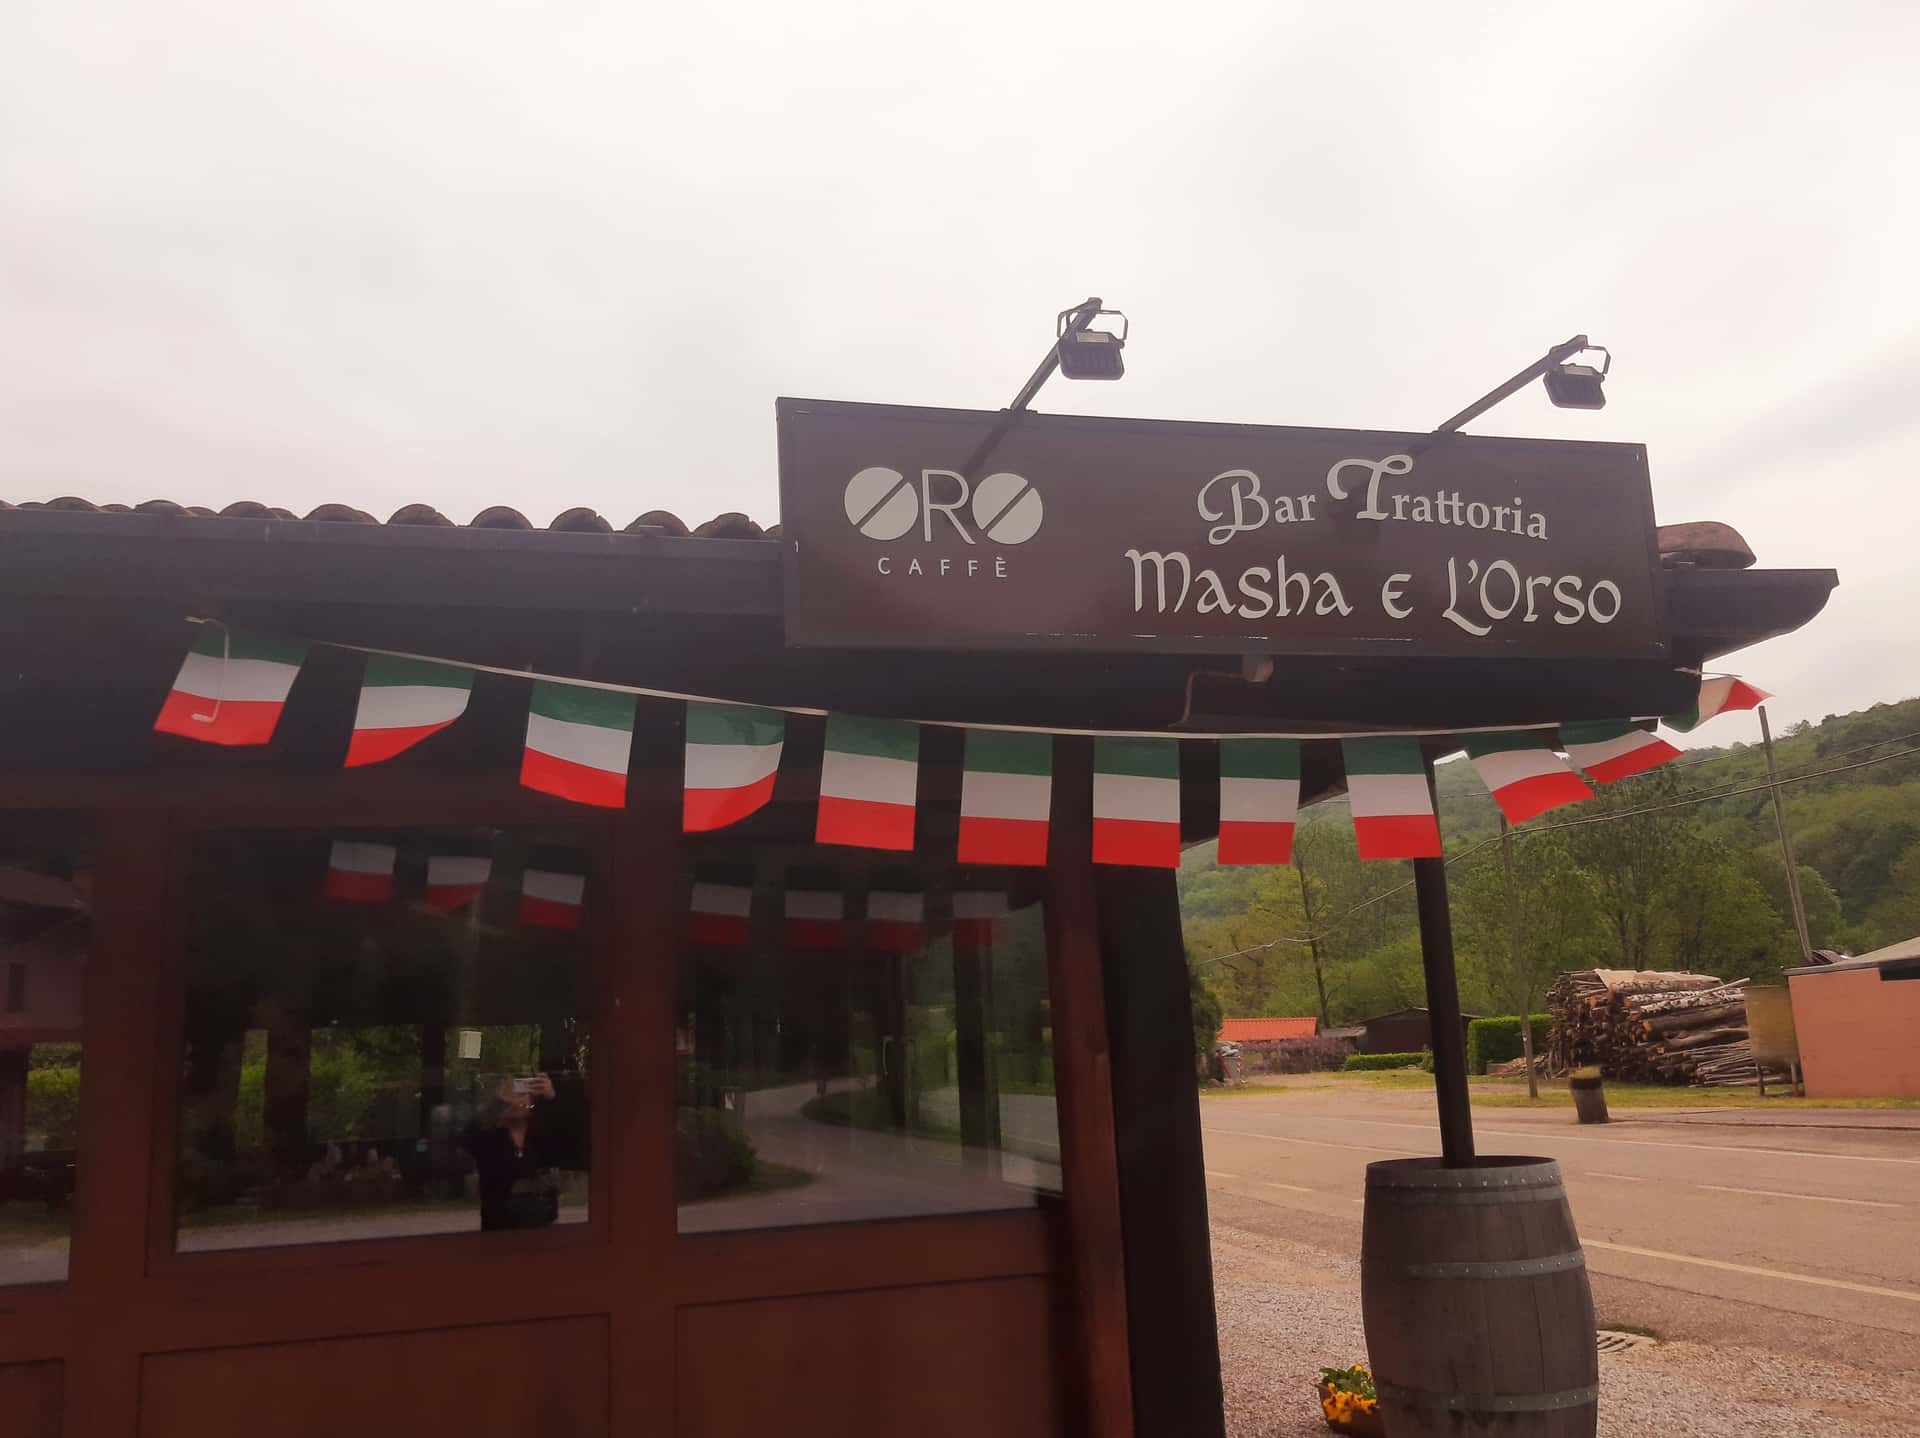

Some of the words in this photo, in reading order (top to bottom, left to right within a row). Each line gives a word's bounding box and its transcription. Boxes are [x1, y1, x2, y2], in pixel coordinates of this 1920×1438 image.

[844, 466, 1044, 545] ORO
[1197, 469, 1316, 546] Bar
[1326, 454, 1549, 540] Trattoria
[877, 556, 1008, 578] CAFFÈ
[1124, 548, 1354, 619] Masha
[1441, 556, 1622, 637] L'Orso
